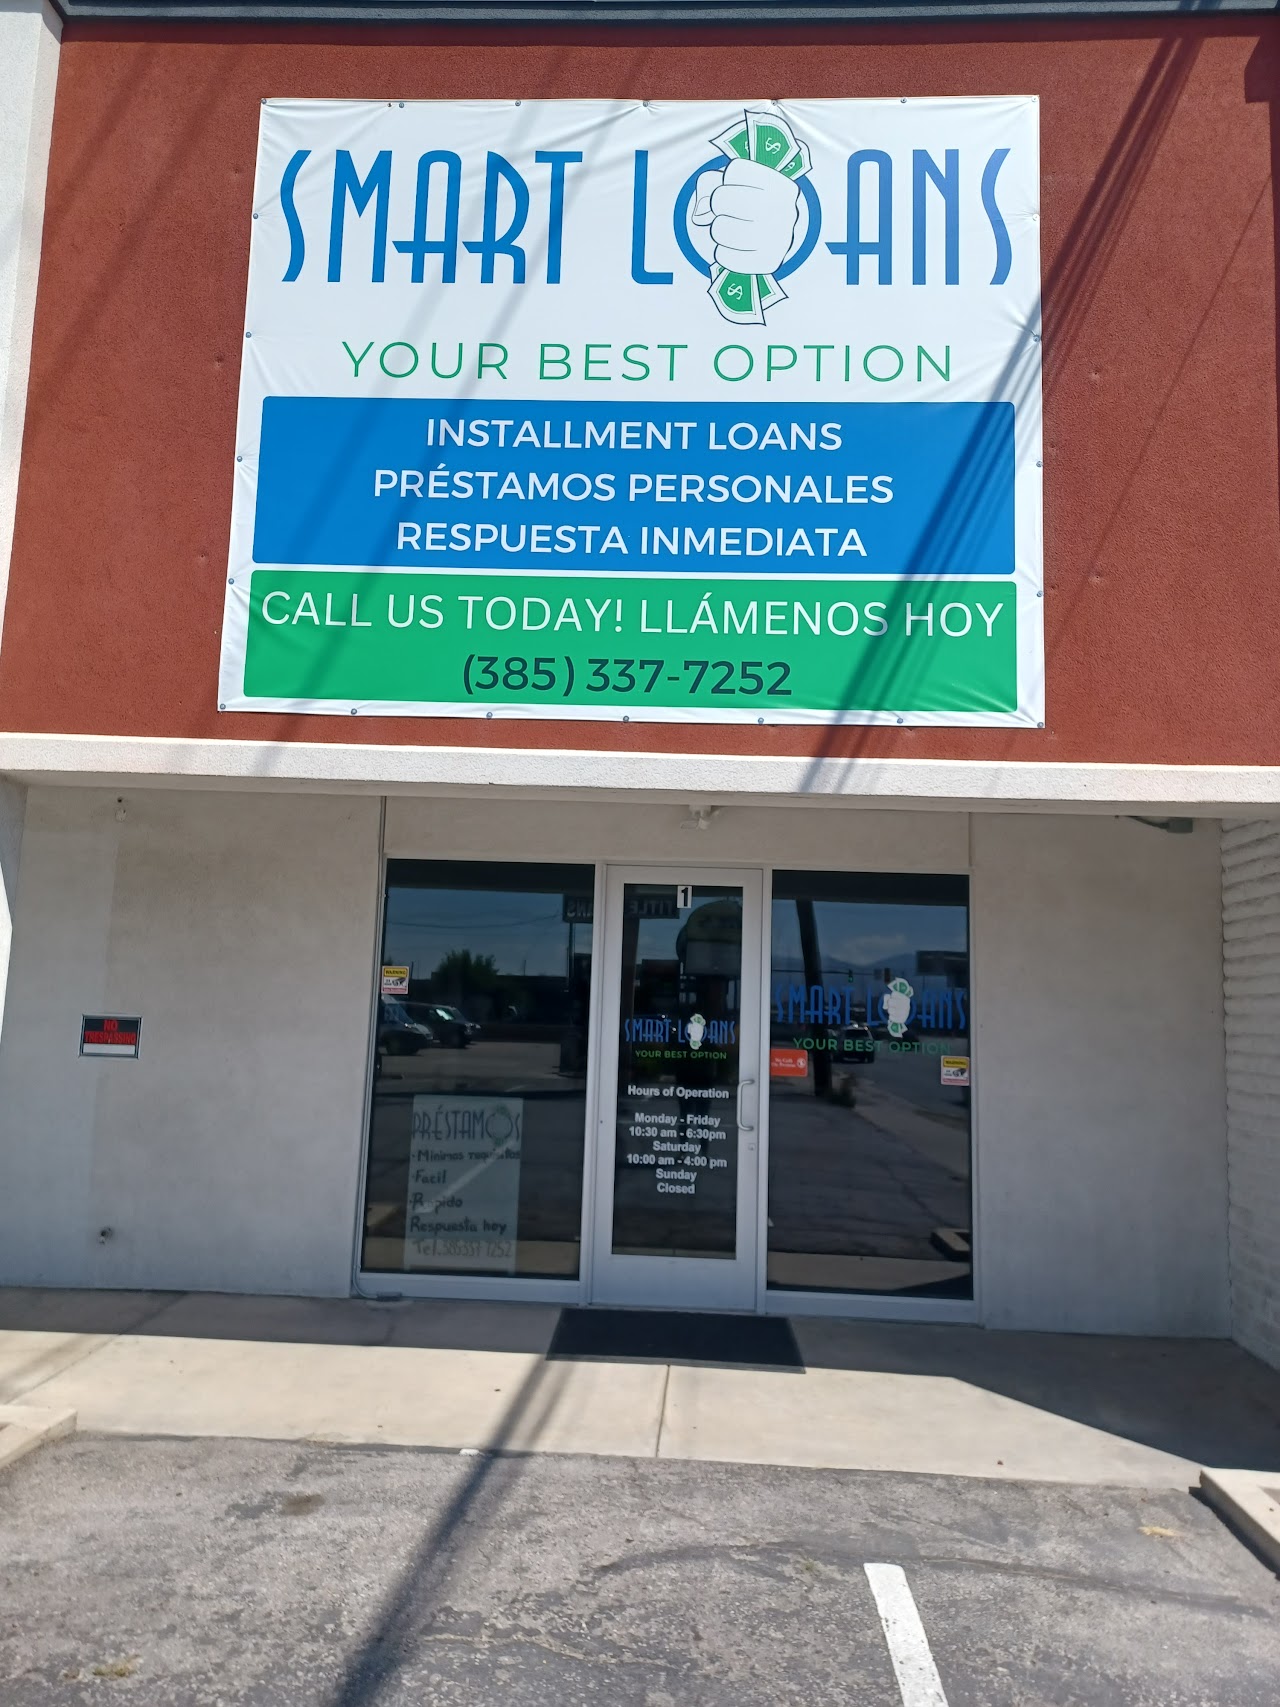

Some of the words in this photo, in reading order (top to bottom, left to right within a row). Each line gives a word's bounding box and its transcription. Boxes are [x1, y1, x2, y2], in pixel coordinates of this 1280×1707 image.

[280, 149, 583, 284] SMART
[631, 147, 1012, 286] LOANS
[341, 341, 508, 380] YOUR
[539, 343, 688, 382] BEST
[713, 344, 950, 382] OPTION
[427, 418, 697, 450] INSTALLMENT
[708, 422, 843, 451] LOANS
[374, 463, 616, 502] PRÉSTAMOS
[628, 474, 894, 504] PERSONALES
[397, 521, 629, 555] RESPUESTA
[640, 526, 868, 557] INMEDIATA
[261, 591, 372, 627] CALL
[387, 594, 444, 629] US
[457, 595, 622, 633] TODAY!
[640, 591, 889, 637] LLÁMENOS
[905, 602, 1004, 637] HOY
[463, 654, 574, 697] (385)
[586, 658, 792, 696] 337-7252
[681, 887, 689, 907] 1
[774, 985, 855, 1025] SMART
[866, 988, 966, 1030] LOANS
[104, 1019, 118, 1032] NO
[624, 1018, 671, 1042] SMART
[678, 1019, 736, 1045] LOANS
[84, 1032, 136, 1044] TRESPASSING
[793, 1038, 838, 1051] YOUR
[843, 1039, 884, 1053] BEST
[888, 1041, 951, 1056] OPTION
[635, 1049, 661, 1058] YOUR
[664, 1050, 688, 1059] BEST
[690, 1051, 727, 1060] OPTION
[627, 1085, 660, 1096] Hours
[662, 1086, 675, 1097] of
[676, 1086, 730, 1099] Operation
[412, 1105, 520, 1142] PRÉSTAMOS
[634, 1112, 677, 1126] Monday
[686, 1114, 721, 1128] Friday
[628, 1126, 658, 1137] 10:30
[660, 1129, 677, 1138] am
[686, 1128, 727, 1141] 6:30pm
[652, 1140, 702, 1154] Saturday
[626, 1153, 656, 1165] 10:00
[657, 1156, 675, 1165] am
[683, 1155, 707, 1166] 4:00
[709, 1158, 728, 1169] pm
[655, 1168, 698, 1182] Sunday
[656, 1182, 696, 1194] Closed
[412, 1192, 463, 1214] Rpido
[410, 1215, 478, 1237] Respuesta
[483, 1218, 508, 1236] hoy
